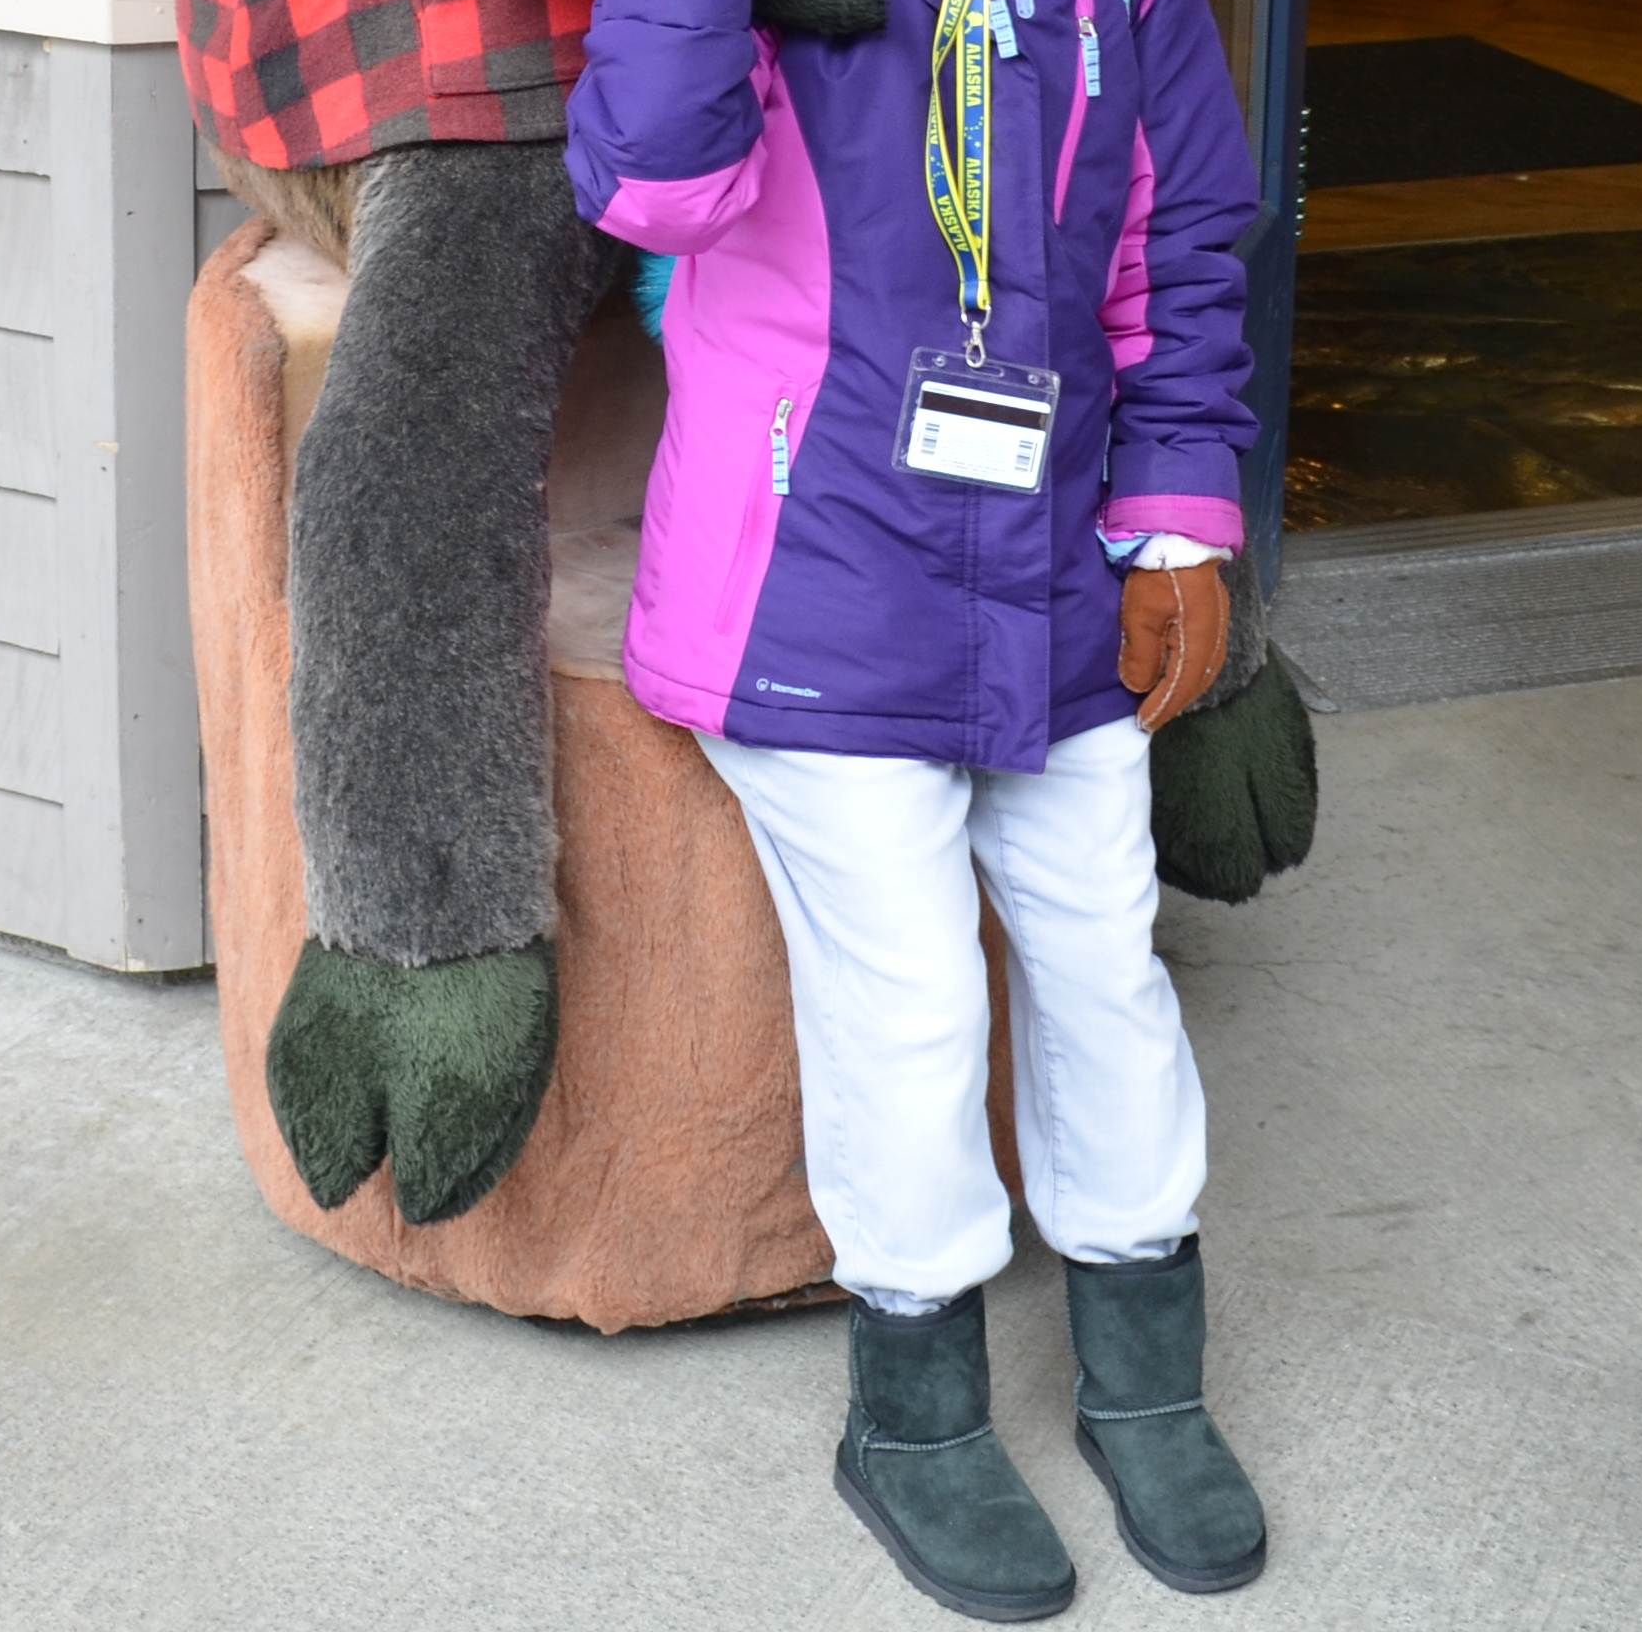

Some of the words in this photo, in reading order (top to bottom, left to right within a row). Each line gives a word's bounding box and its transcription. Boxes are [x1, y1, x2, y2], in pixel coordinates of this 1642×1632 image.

[966, 43, 982, 107] ALASKA
[966, 157, 982, 221] ALASKA
[937, 195, 970, 252] ALASKA
